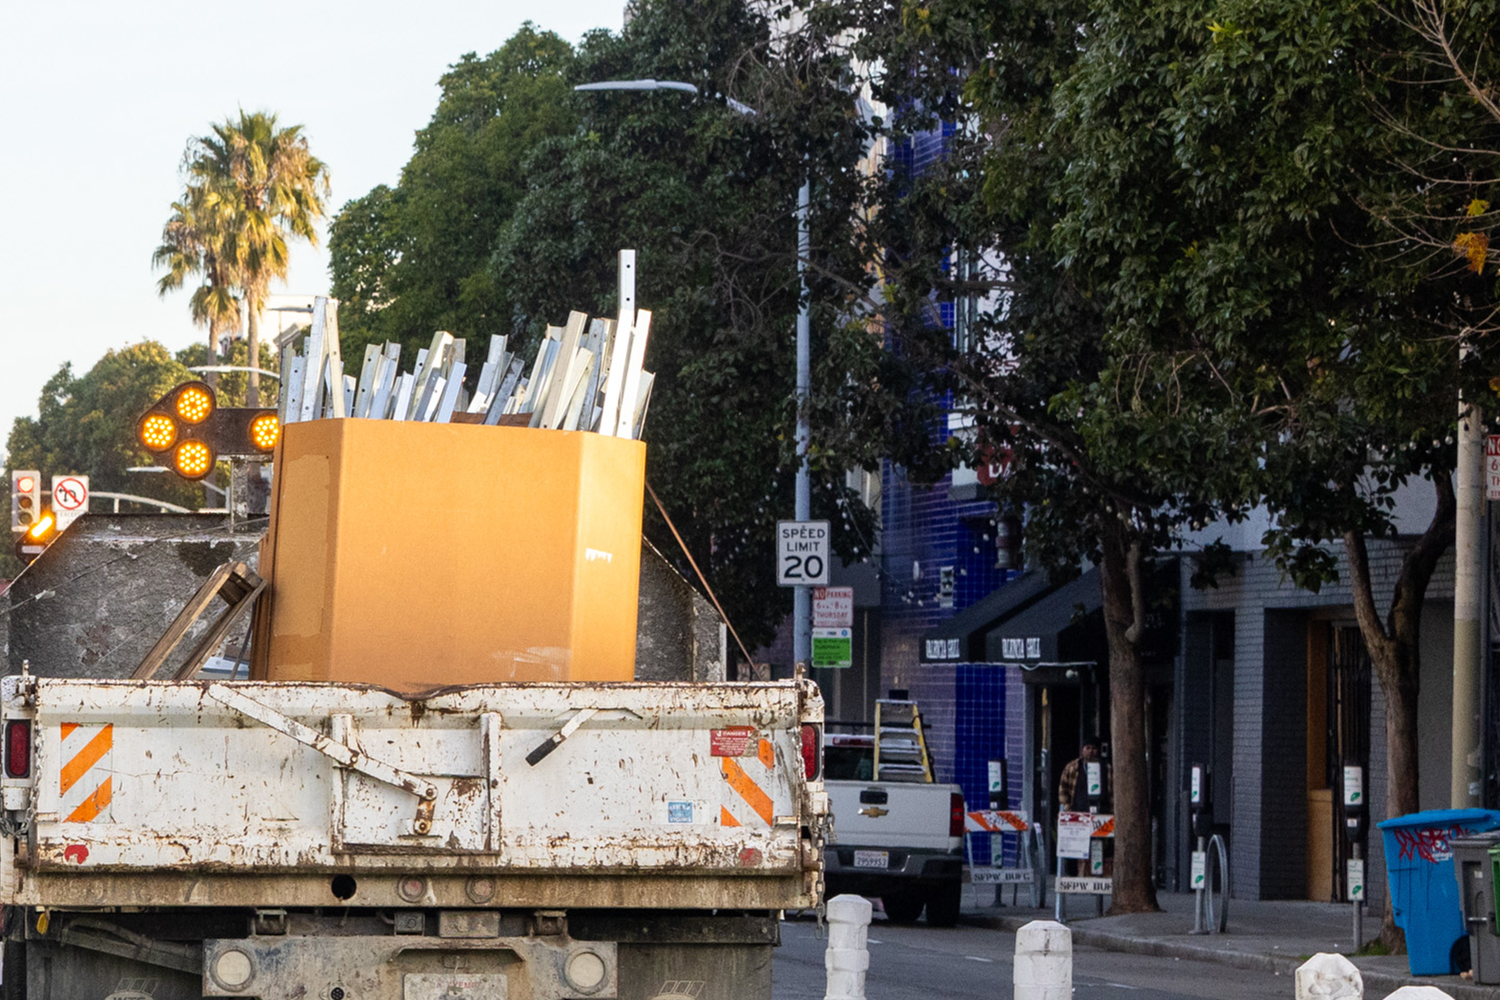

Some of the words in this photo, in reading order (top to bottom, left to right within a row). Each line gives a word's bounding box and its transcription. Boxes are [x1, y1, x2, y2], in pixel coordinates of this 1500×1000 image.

[782, 528, 826, 539] SPEED
[786, 541, 820, 552] LIMIT
[783, 555, 823, 578] 20
[814, 588, 825, 599] NO
[826, 590, 851, 599] PARKING
